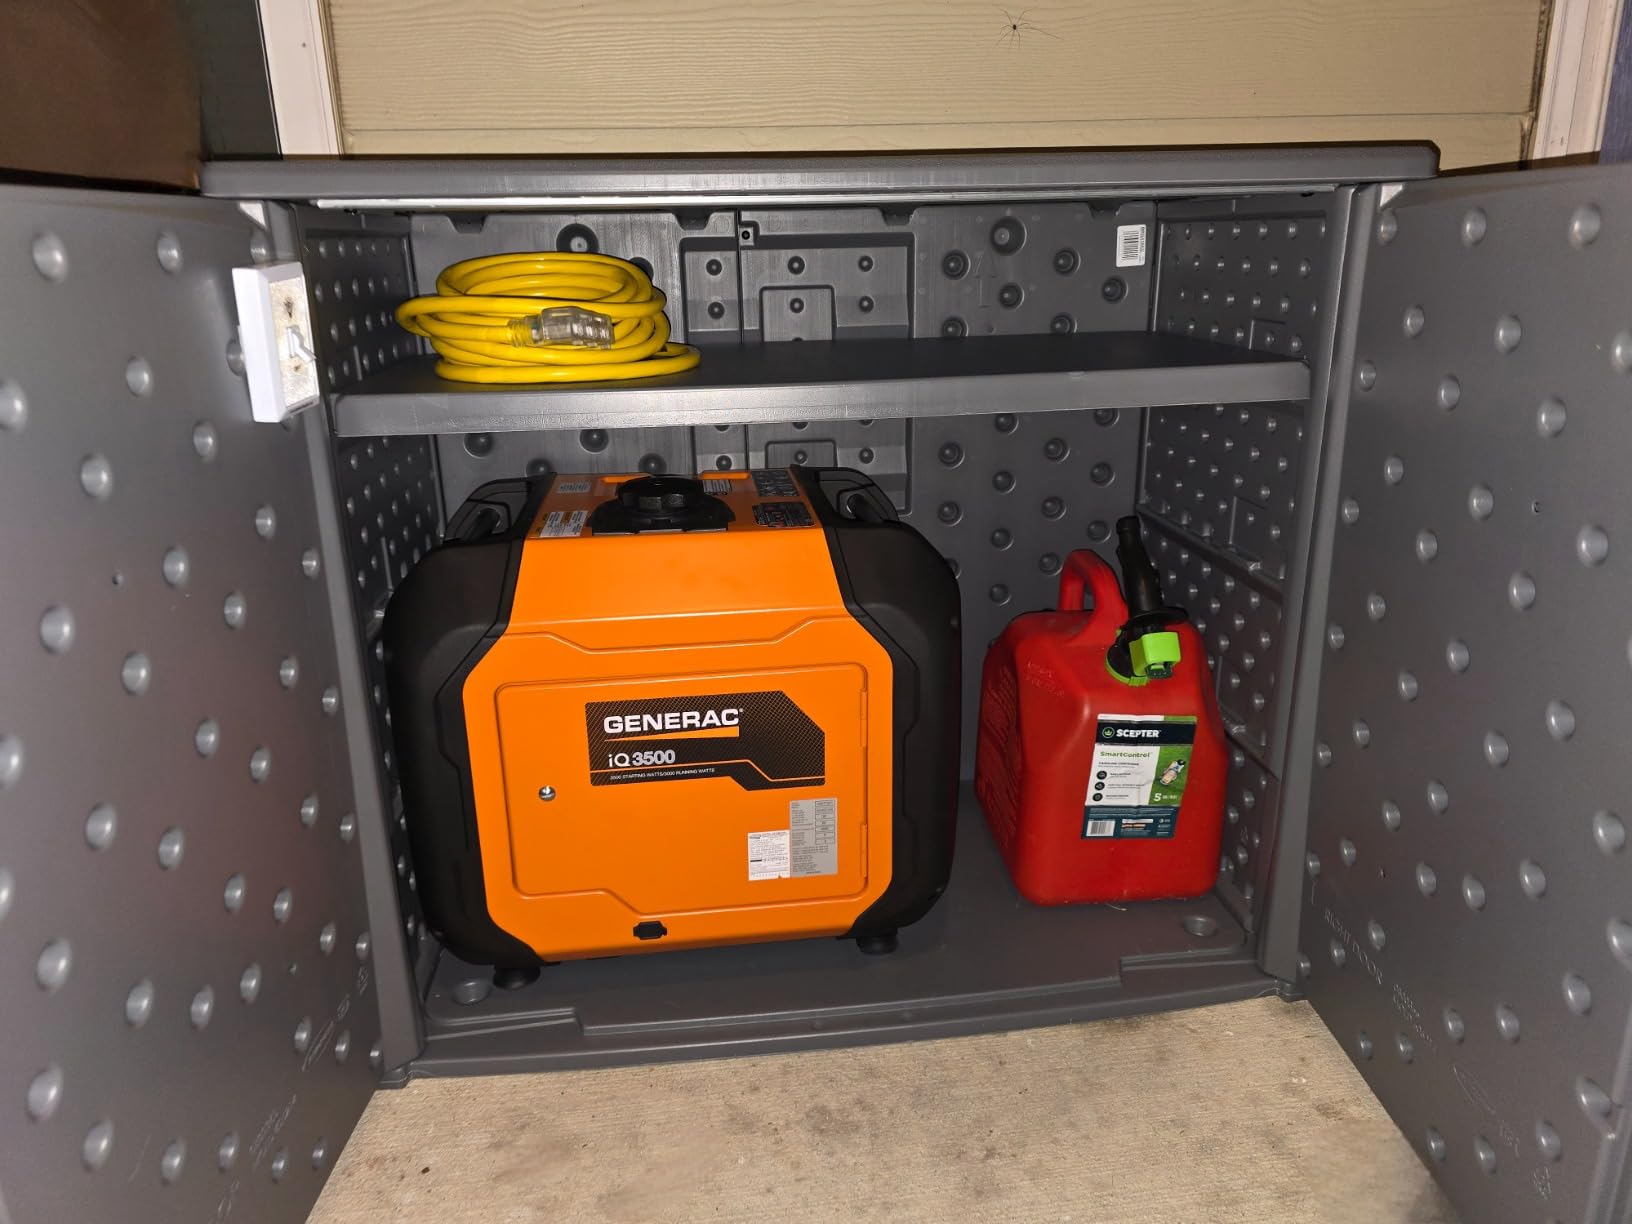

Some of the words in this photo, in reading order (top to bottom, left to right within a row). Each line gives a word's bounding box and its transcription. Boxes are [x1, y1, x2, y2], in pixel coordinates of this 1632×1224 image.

[603, 708, 740, 734] GENERAC
[1116, 728, 1159, 738] SCEPTER
[1352, 943, 1383, 985] DOOR
